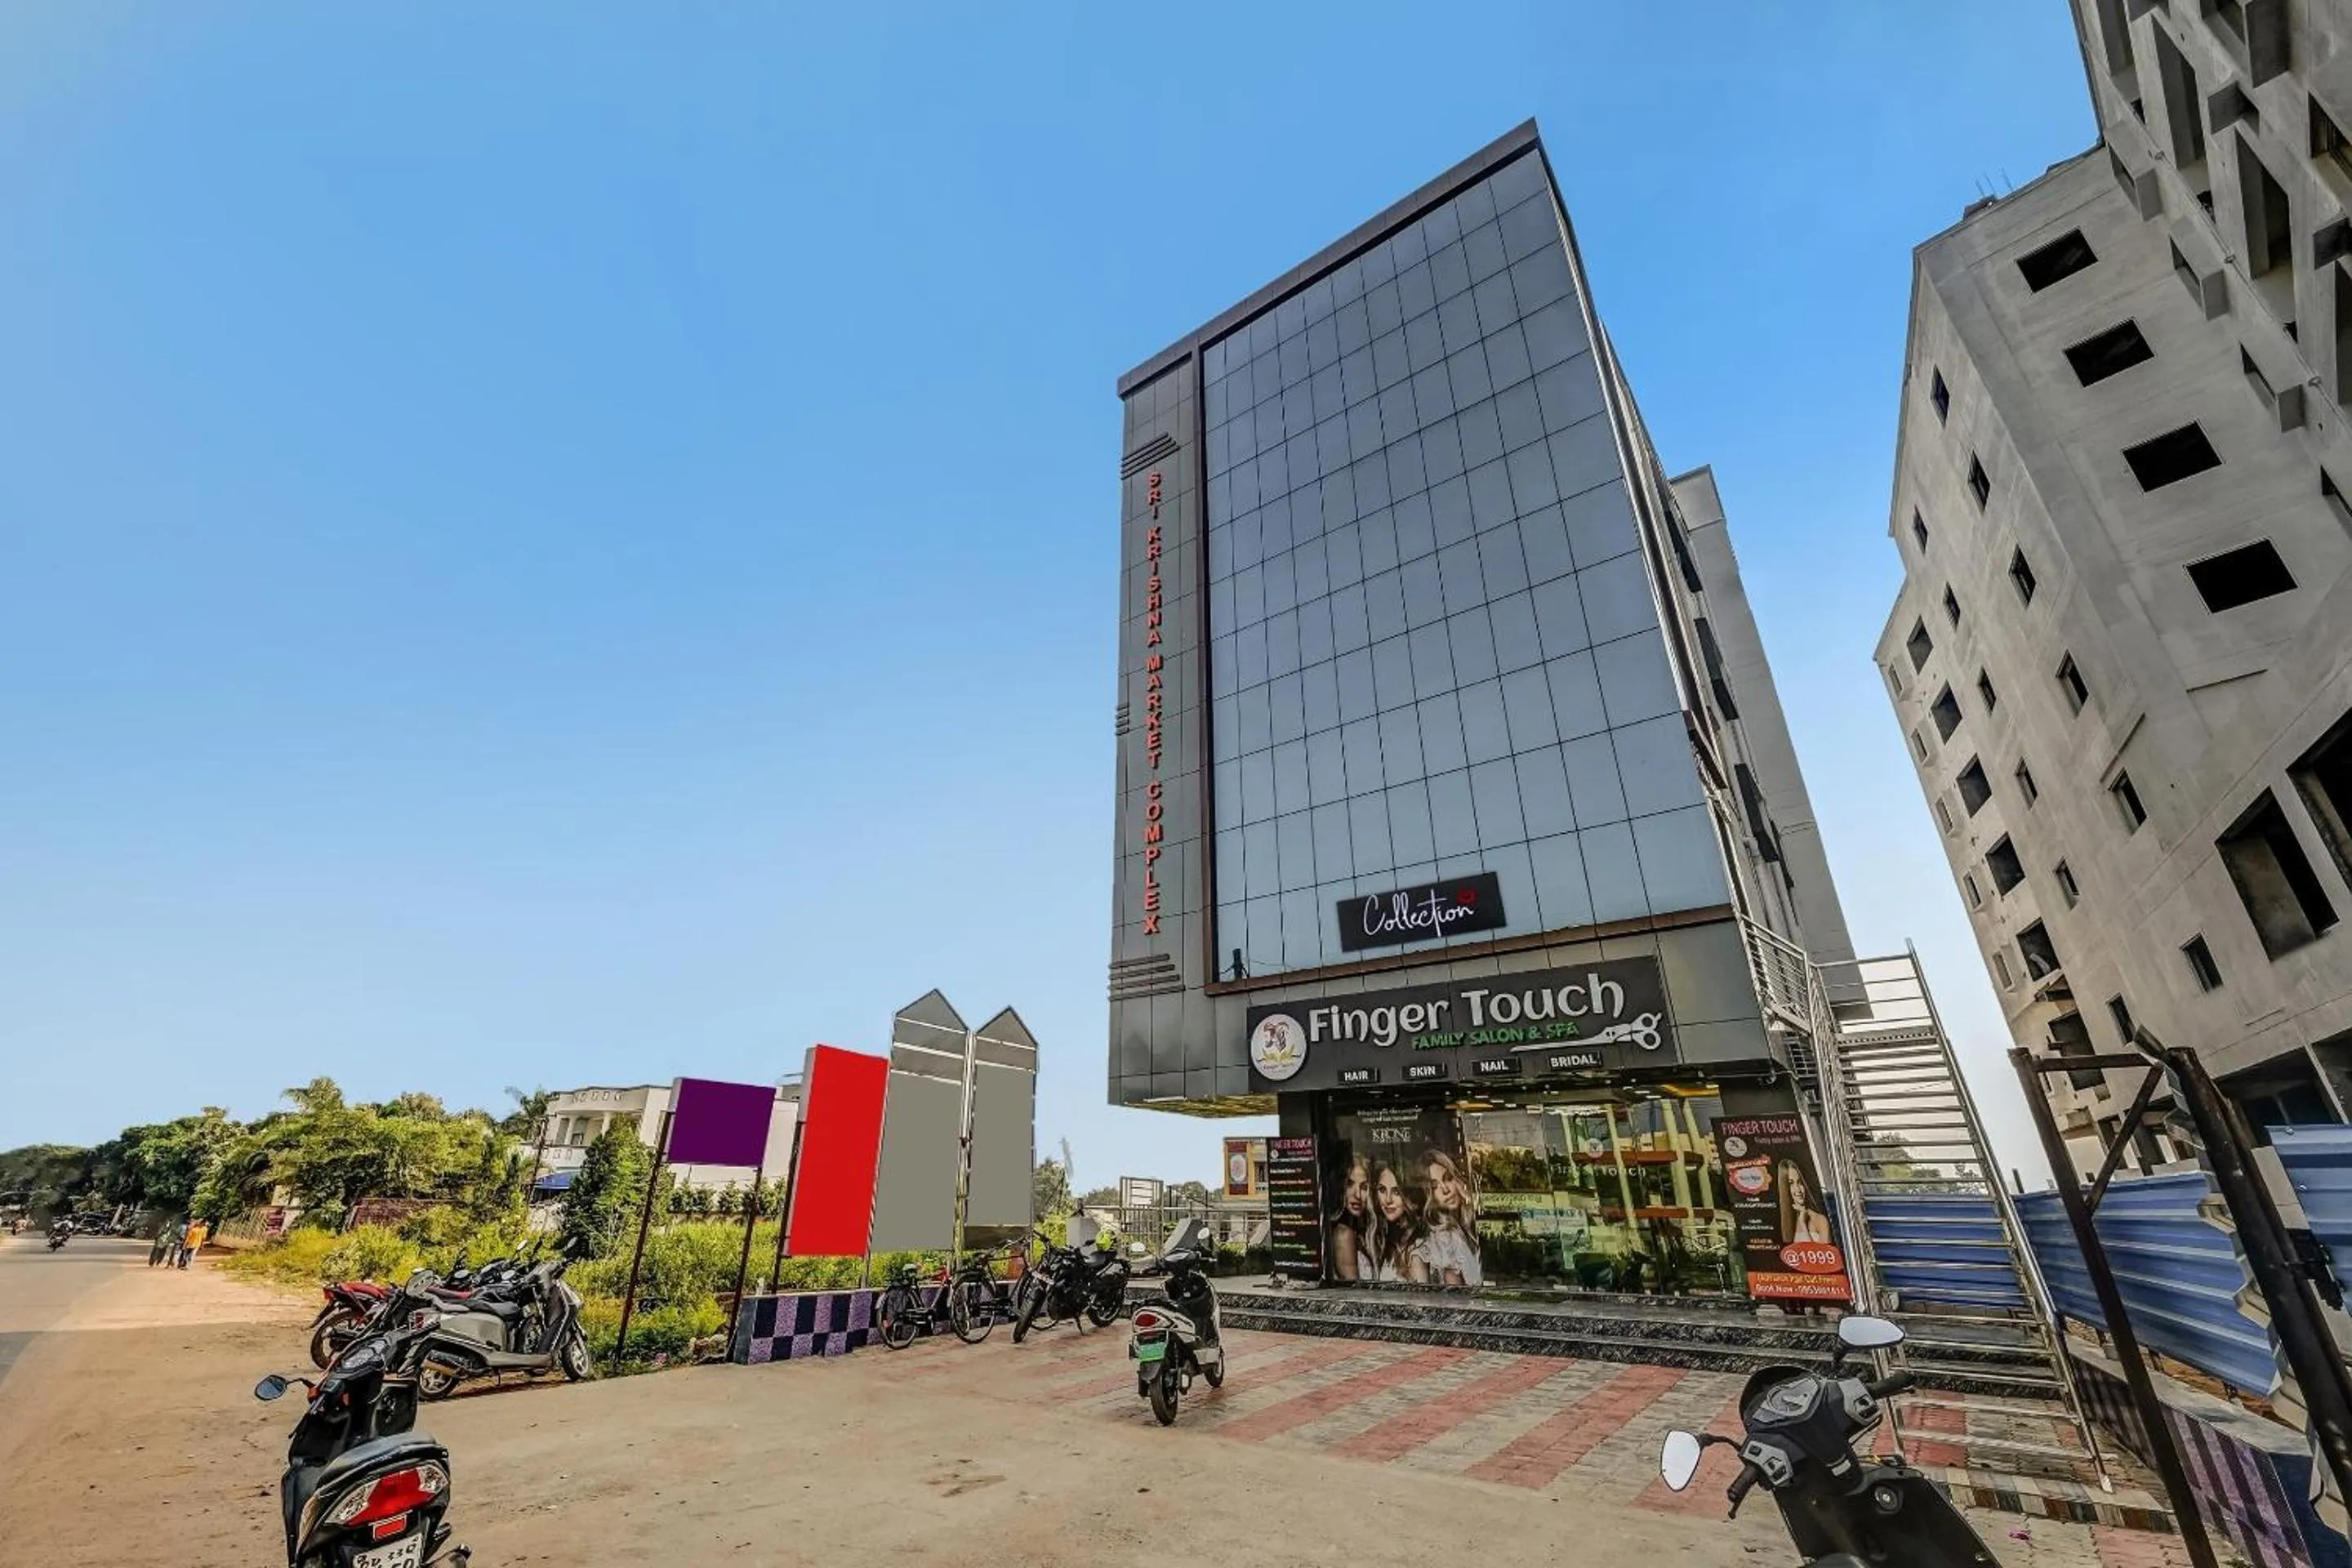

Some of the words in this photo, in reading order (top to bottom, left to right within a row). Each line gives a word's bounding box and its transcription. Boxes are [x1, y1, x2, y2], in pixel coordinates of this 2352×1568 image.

[1148, 471, 1161, 519] SRI
[1147, 526, 1162, 648] KRISHNA
[1146, 653, 1164, 770] MARKET
[1143, 779, 1163, 935] COMPLEX
[1363, 888, 1475, 938] Collection
[1308, 1000, 1450, 1047] Finger
[1460, 973, 1624, 1027] Touch
[1411, 1031, 1464, 1050] FAMILY
[1470, 1027, 1524, 1045] SALON
[1409, 1065, 1436, 1077] SKIN
[1480, 1060, 1509, 1072] NAIL
[1550, 1053, 1597, 1068] BRIDAL
[1344, 1070, 1369, 1082] HAIR
[1759, 1118, 1798, 1134] TOUCH
[1784, 1249, 1836, 1267] @1999
